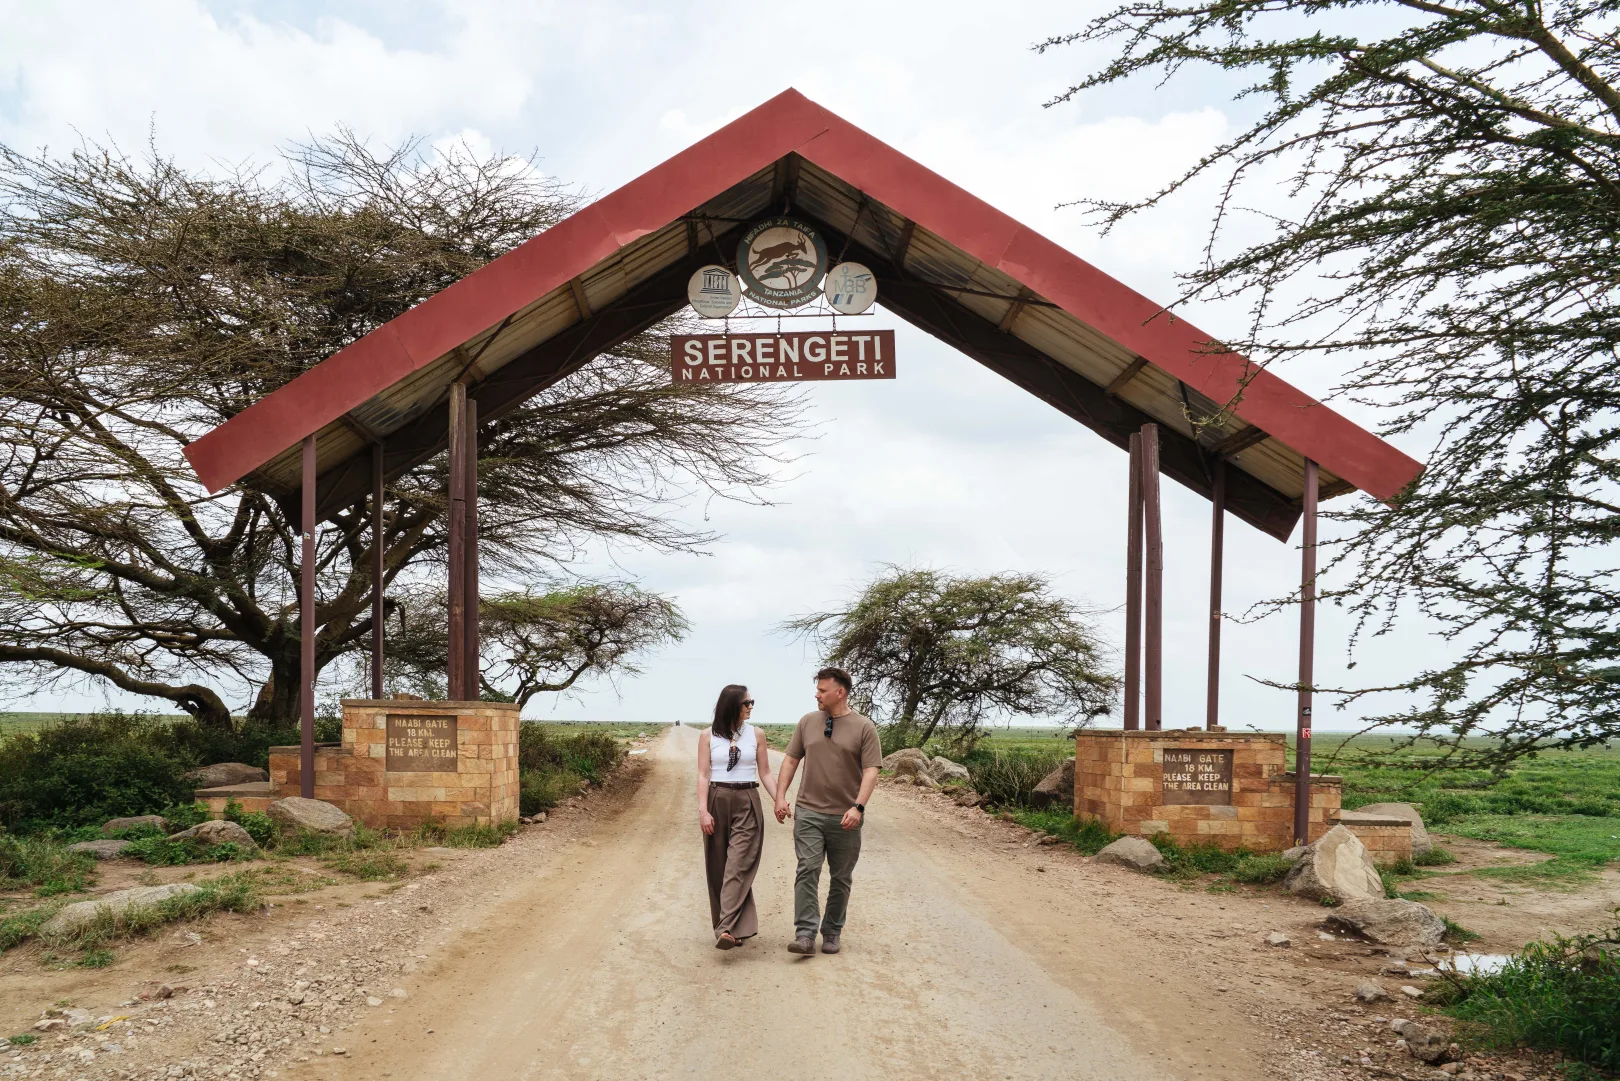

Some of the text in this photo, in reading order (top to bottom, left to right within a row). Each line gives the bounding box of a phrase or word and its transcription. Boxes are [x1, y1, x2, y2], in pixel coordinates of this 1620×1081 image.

[793, 221, 816, 239] TAIFA
[764, 288, 803, 297] TANZANIA
[749, 291, 817, 306] NATIONAL PARKS
[684, 335, 882, 366] SERENGETI
[682, 362, 885, 380] NATIONAL PARK
[395, 719, 448, 728] NAABI GATE
[407, 728, 416, 737] 18
[389, 738, 451, 748] PLEASE KEEP
[389, 748, 404, 757] THE
[408, 748, 429, 758] AREA
[1164, 753, 1225, 763] NAABI GATE
[1185, 764, 1195, 772] 18
[1163, 773, 1221, 781] PLEASE KEEP
[1163, 782, 1229, 791] THE AREA CLEAN
